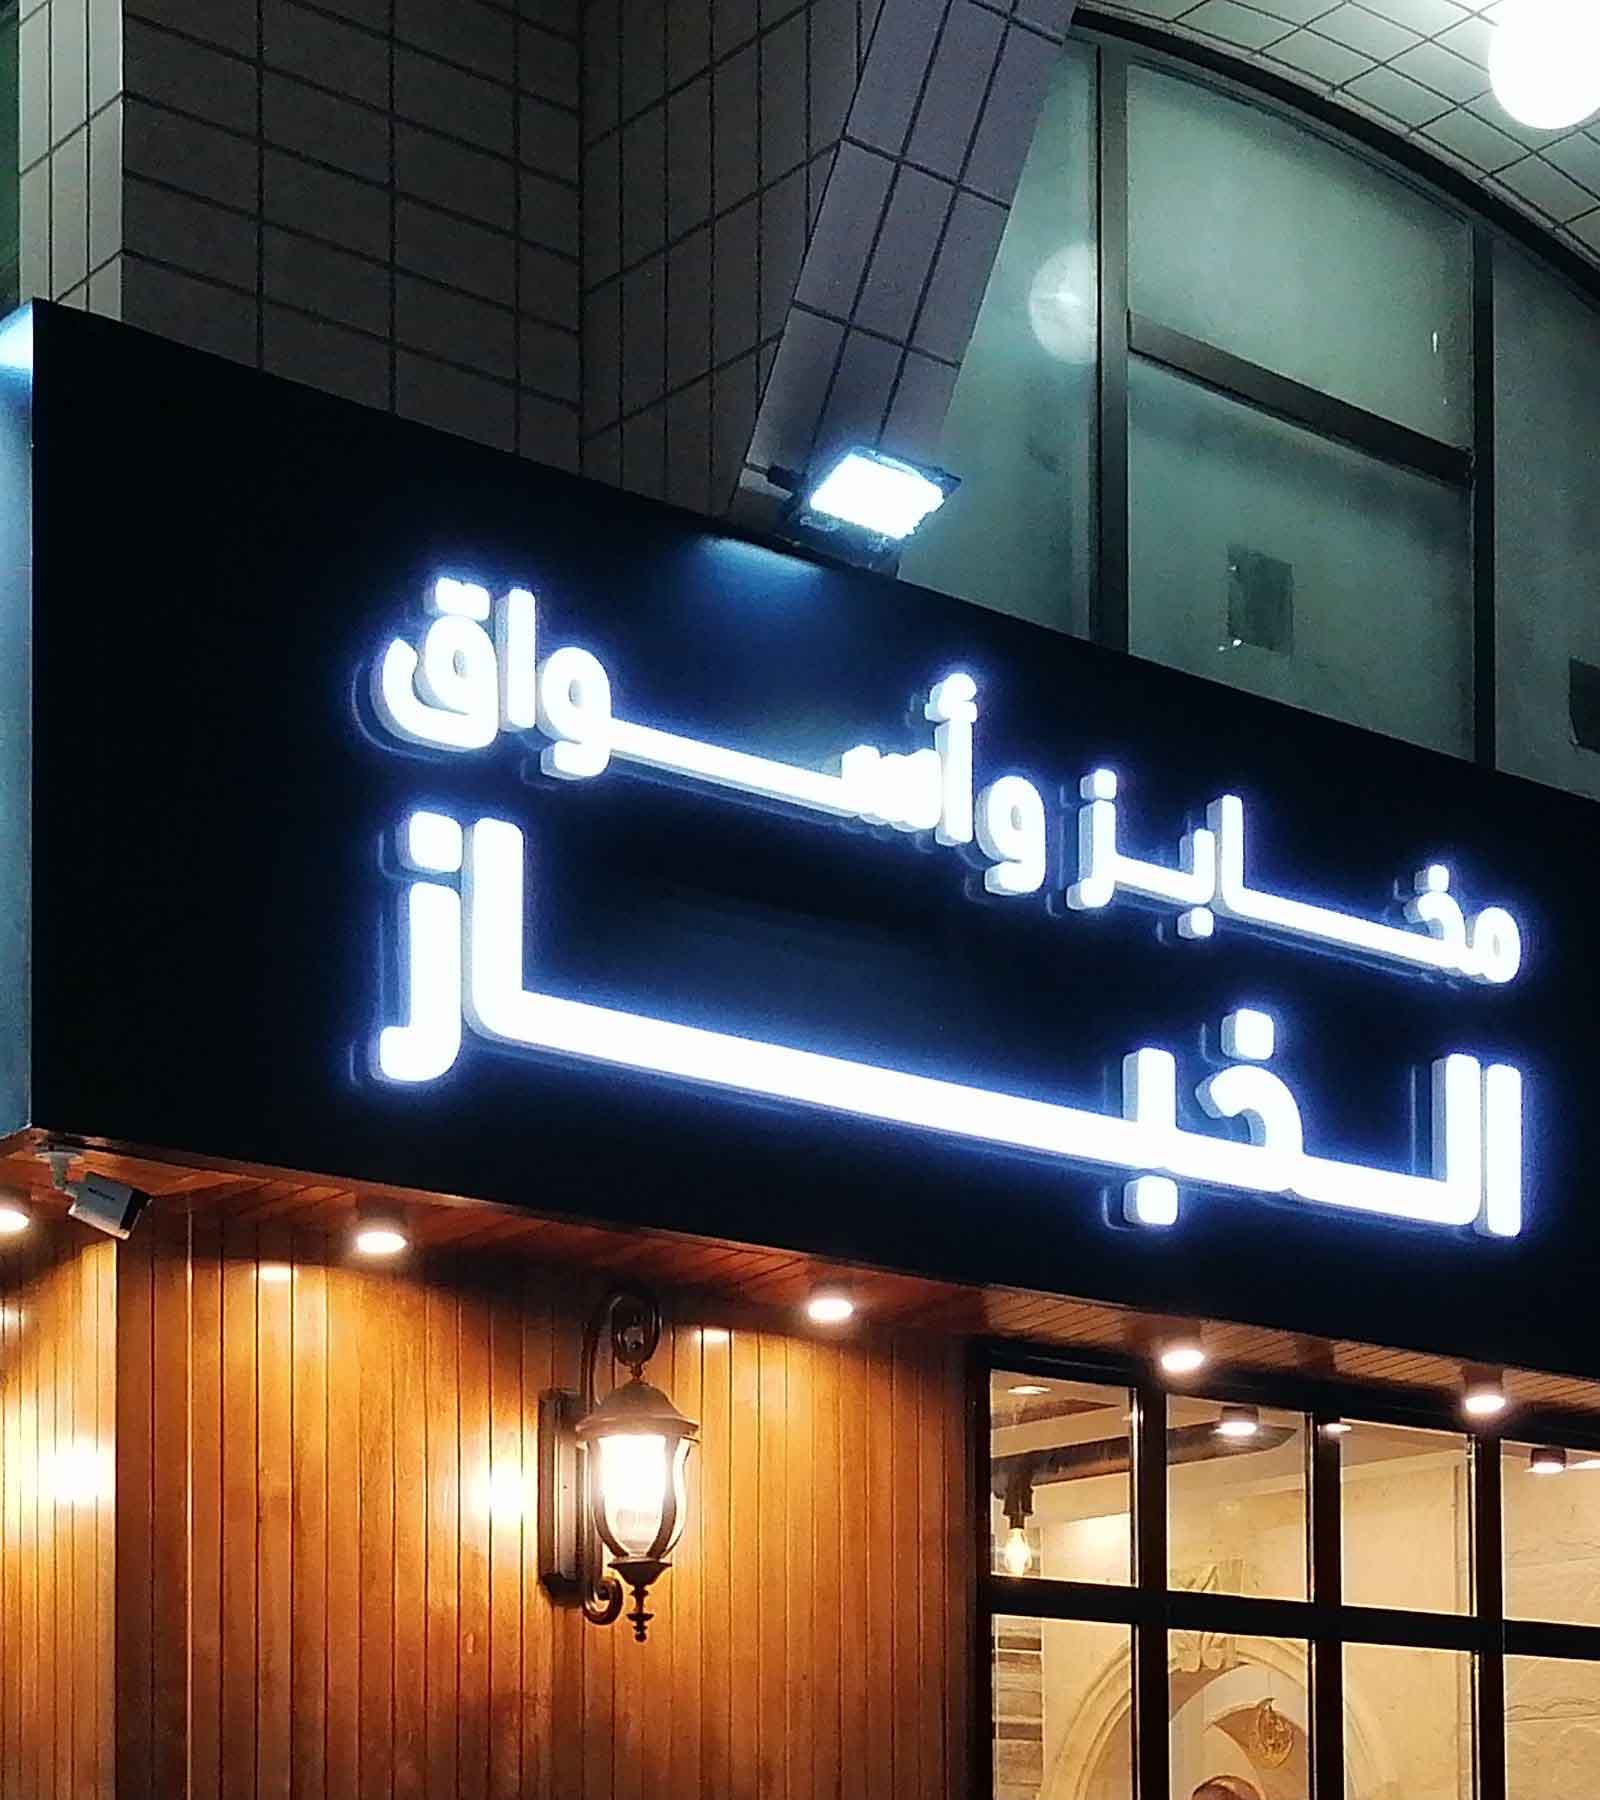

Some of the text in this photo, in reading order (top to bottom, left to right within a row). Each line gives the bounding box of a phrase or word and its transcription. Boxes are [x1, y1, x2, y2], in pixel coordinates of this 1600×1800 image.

[370, 578, 1525, 986] مخابز وأسواق
[368, 808, 1525, 1239] الخباز
